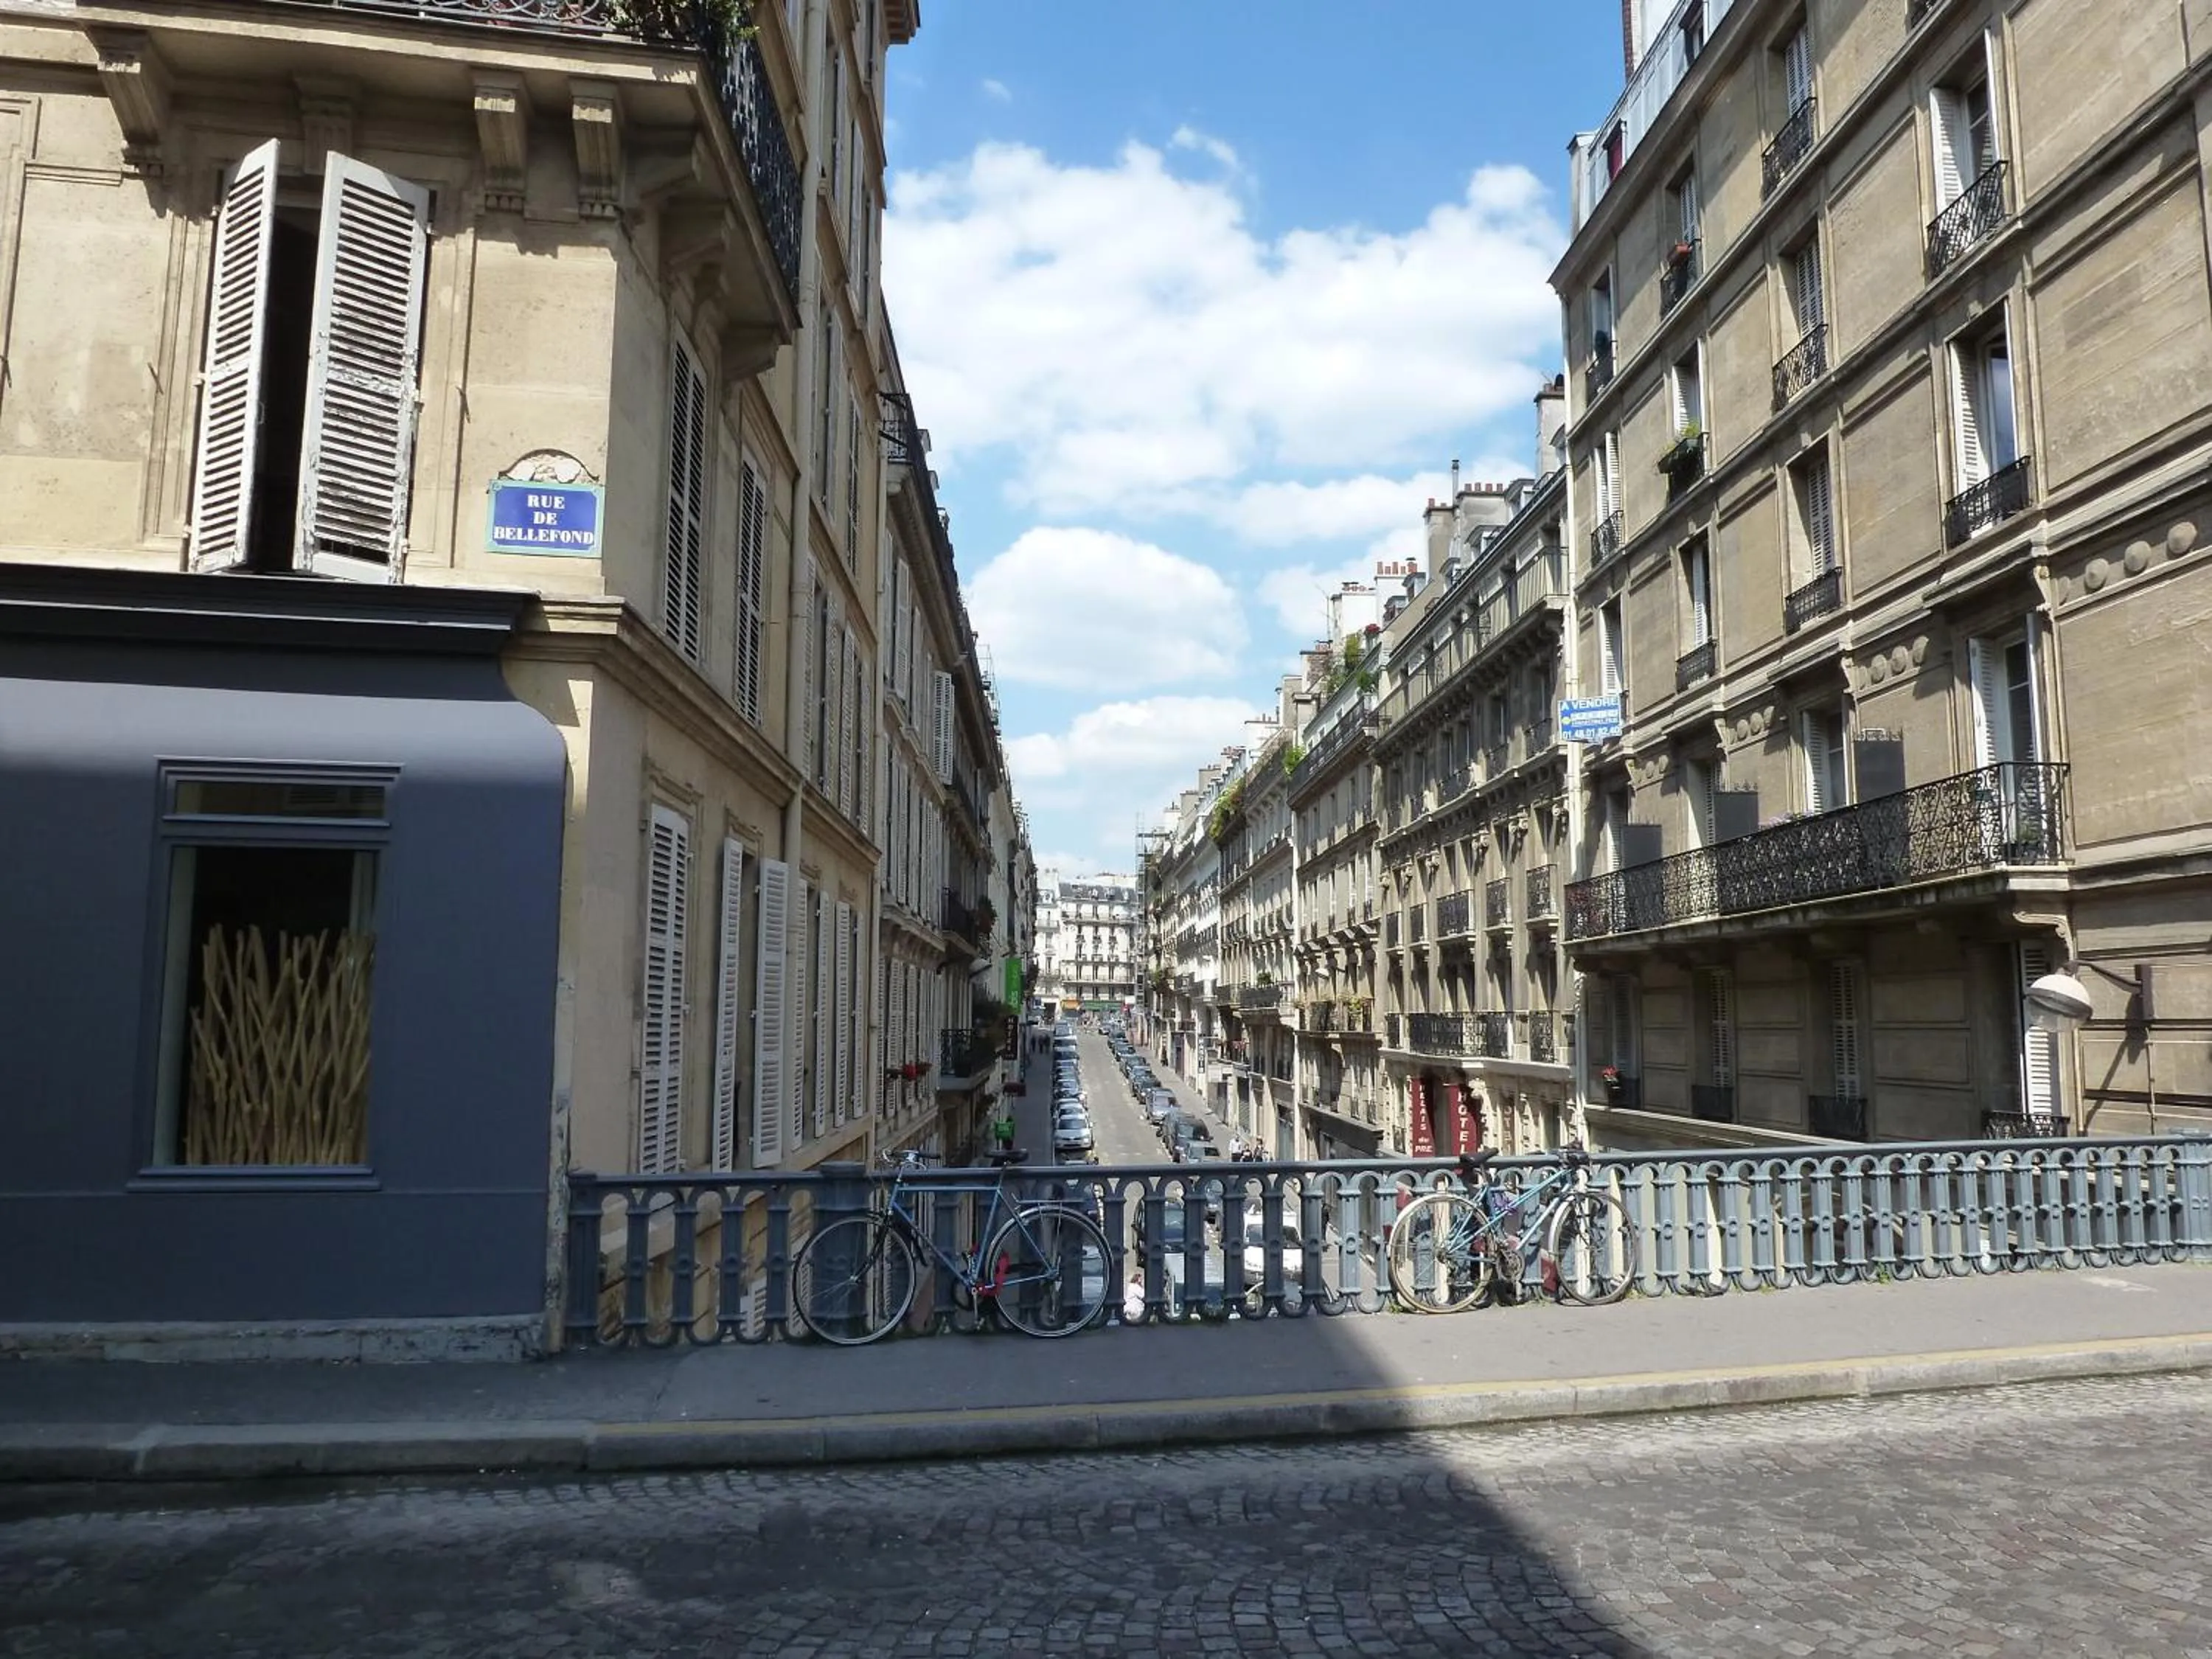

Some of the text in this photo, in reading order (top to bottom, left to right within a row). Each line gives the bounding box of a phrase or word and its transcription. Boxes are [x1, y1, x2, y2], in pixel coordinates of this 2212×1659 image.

[527, 494, 566, 509] RUE
[532, 511, 558, 526] DE
[493, 526, 594, 544] BELLEFOND
[1561, 697, 1618, 711] A VENDRE
[1458, 1091, 1470, 1155] HOTEL
